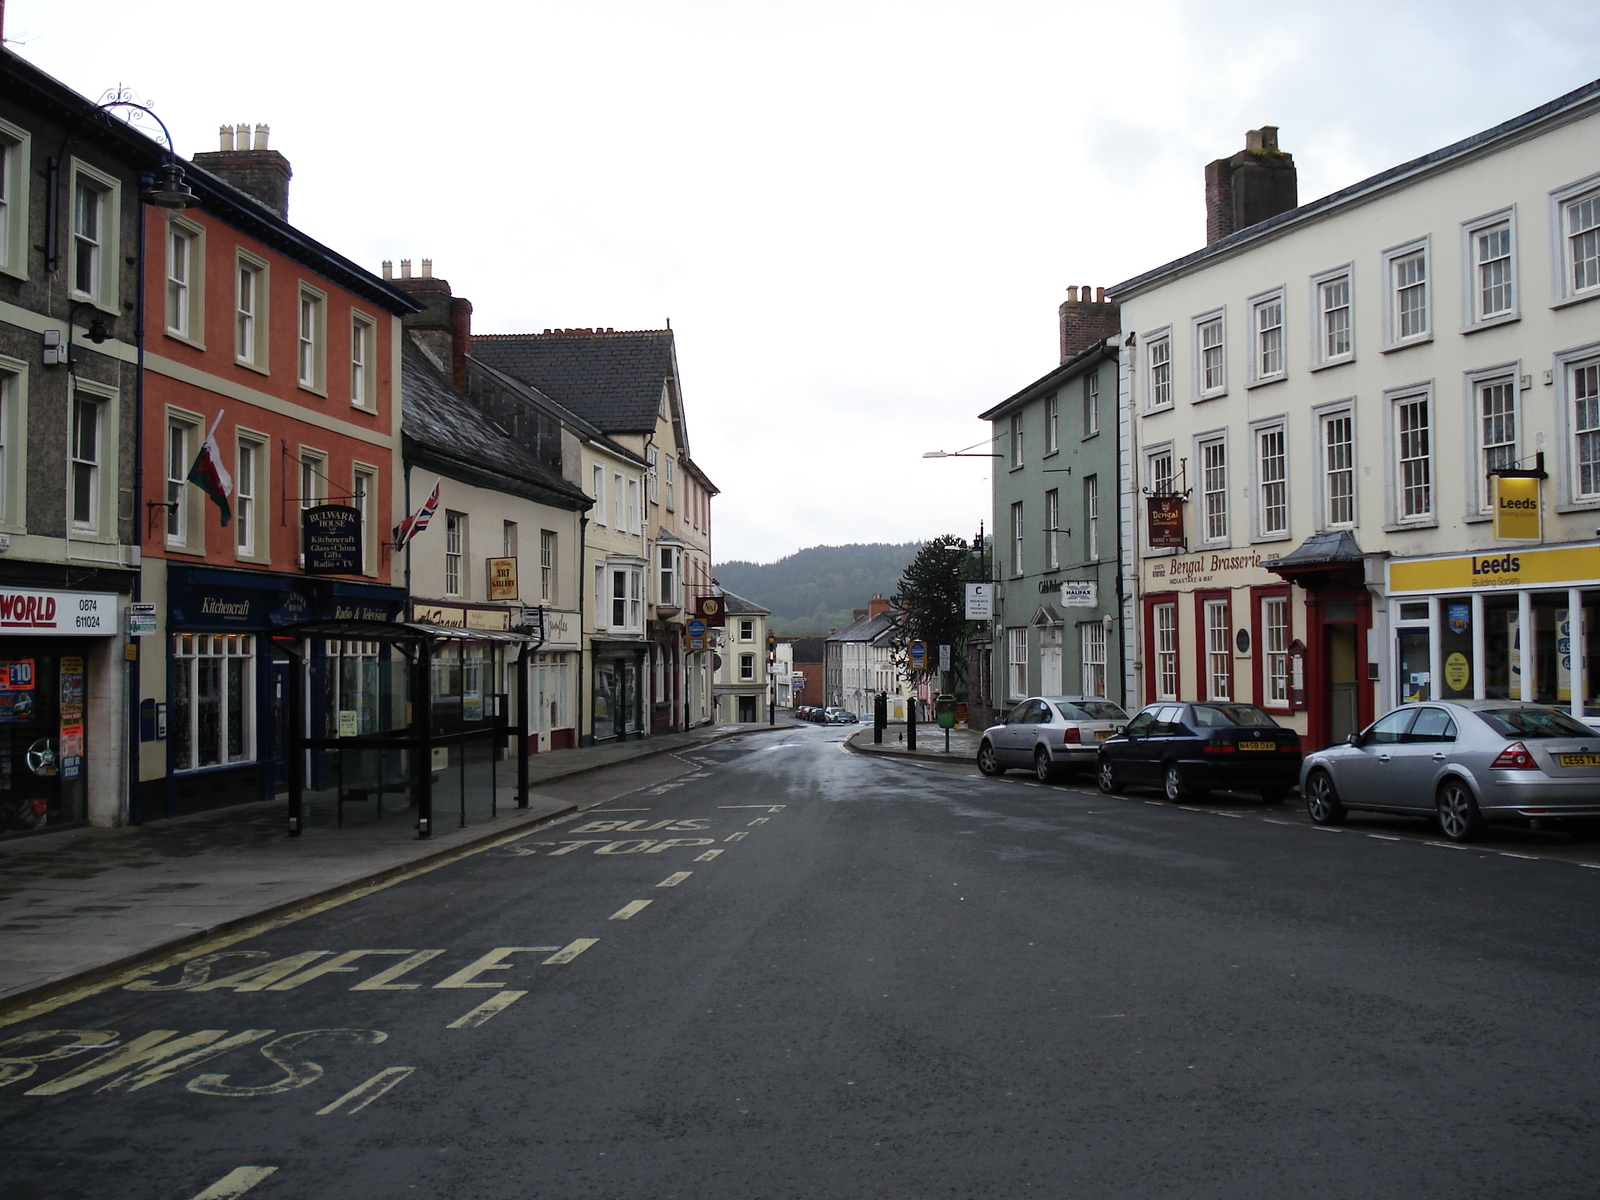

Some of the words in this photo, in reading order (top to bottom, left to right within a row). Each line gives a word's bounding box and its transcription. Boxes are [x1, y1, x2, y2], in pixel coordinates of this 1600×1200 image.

[1500, 496, 1537, 510] Leeds
[309, 511, 356, 523] BULWARK
[1152, 509, 1179, 521] Bengal
[323, 551, 342, 559] Gifts
[313, 560, 335, 568] Radio
[1169, 555, 1205, 578] Bengal
[1209, 550, 1262, 572] Brasserie
[1472, 553, 1521, 575] Leeds
[497, 568, 510, 577] ART
[1472, 578, 1497, 588] Building
[1497, 576, 1521, 587] Society
[0, 594, 57, 625] WORLD
[79, 599, 97, 611] 0874
[201, 597, 250, 616] Kitchencraft
[334, 605, 353, 619] Radio
[353, 607, 361, 619] &
[362, 607, 388, 622] Television
[75, 616, 101, 628] 611024
[1239, 742, 1259, 750] N458
[1563, 755, 1585, 765] CE55
[567, 818, 715, 834] BUS
[487, 837, 716, 857] STOP
[121, 947, 562, 993] SAFLE
